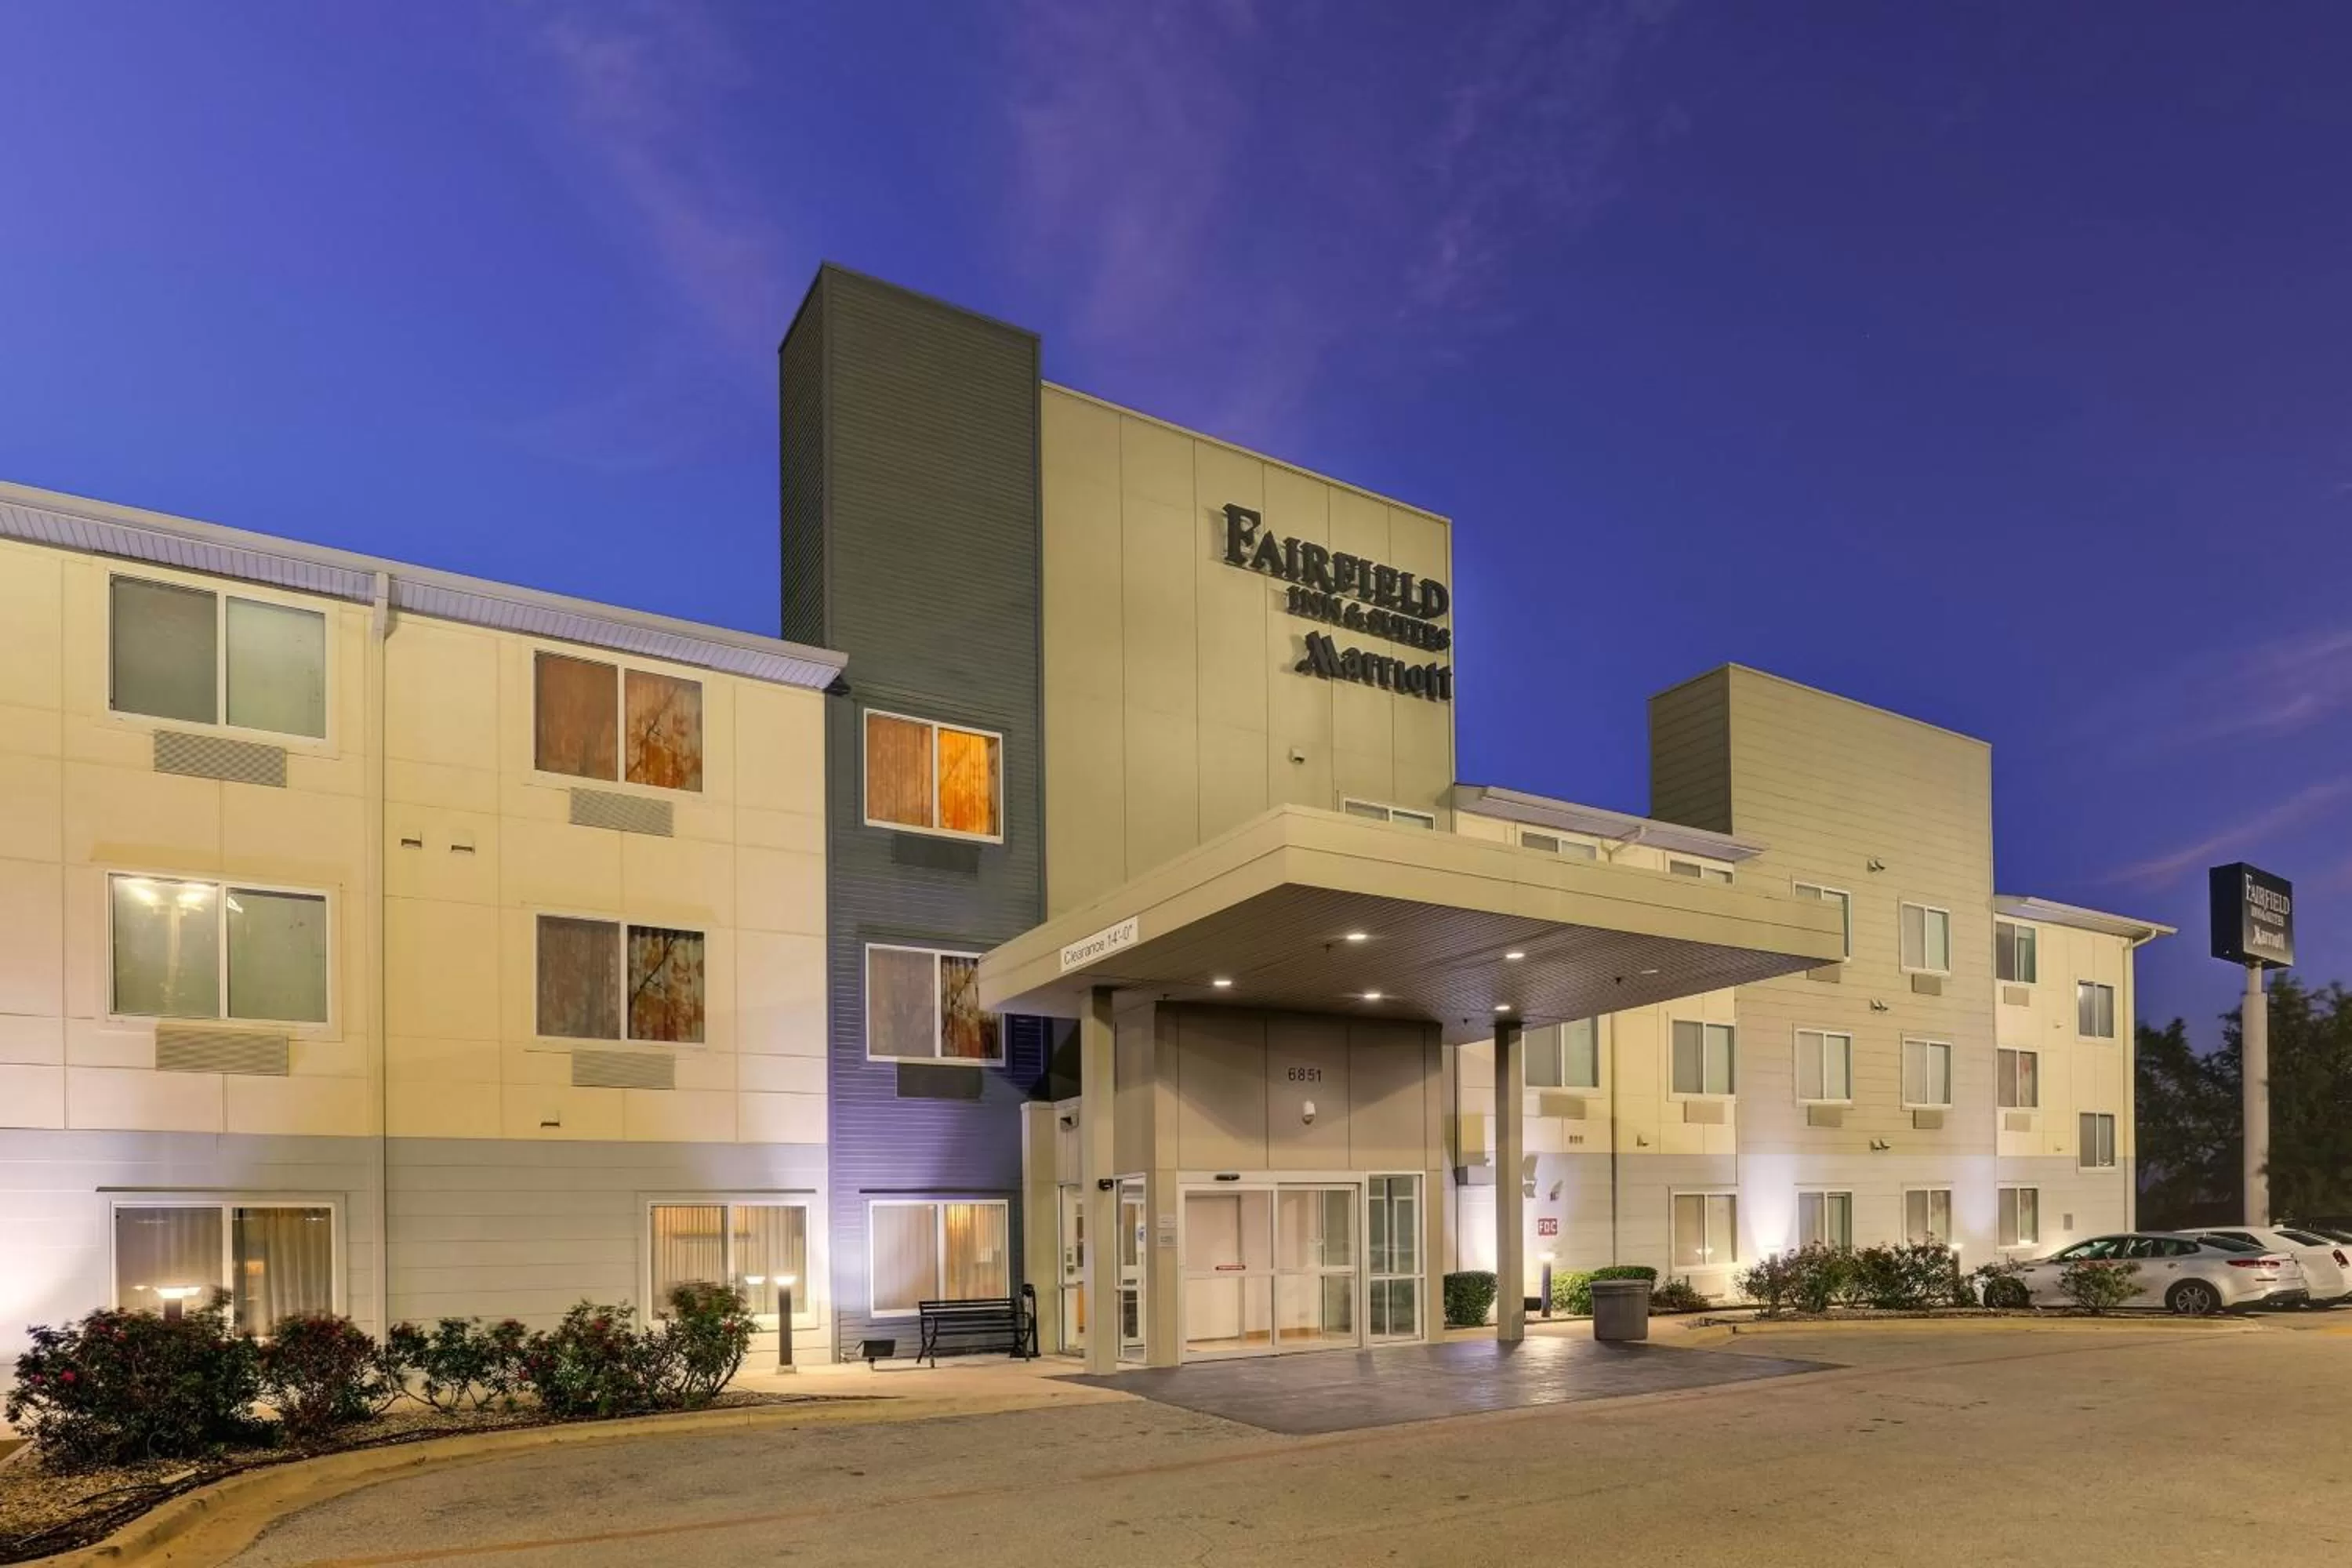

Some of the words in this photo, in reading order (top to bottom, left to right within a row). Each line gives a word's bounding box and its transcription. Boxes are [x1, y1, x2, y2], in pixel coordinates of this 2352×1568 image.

[1222, 503, 1450, 619] FAIRFIELD
[1286, 585, 1343, 627] INN
[1343, 602, 1367, 633] &
[1366, 608, 1450, 653] SUITES
[1294, 630, 1452, 702] Marriott
[2245, 873, 2290, 915] FAIRFIELD
[1064, 940, 1105, 965] Clearance
[1288, 1067, 1322, 1083] 6851
[1539, 1221, 1556, 1233] FDC
